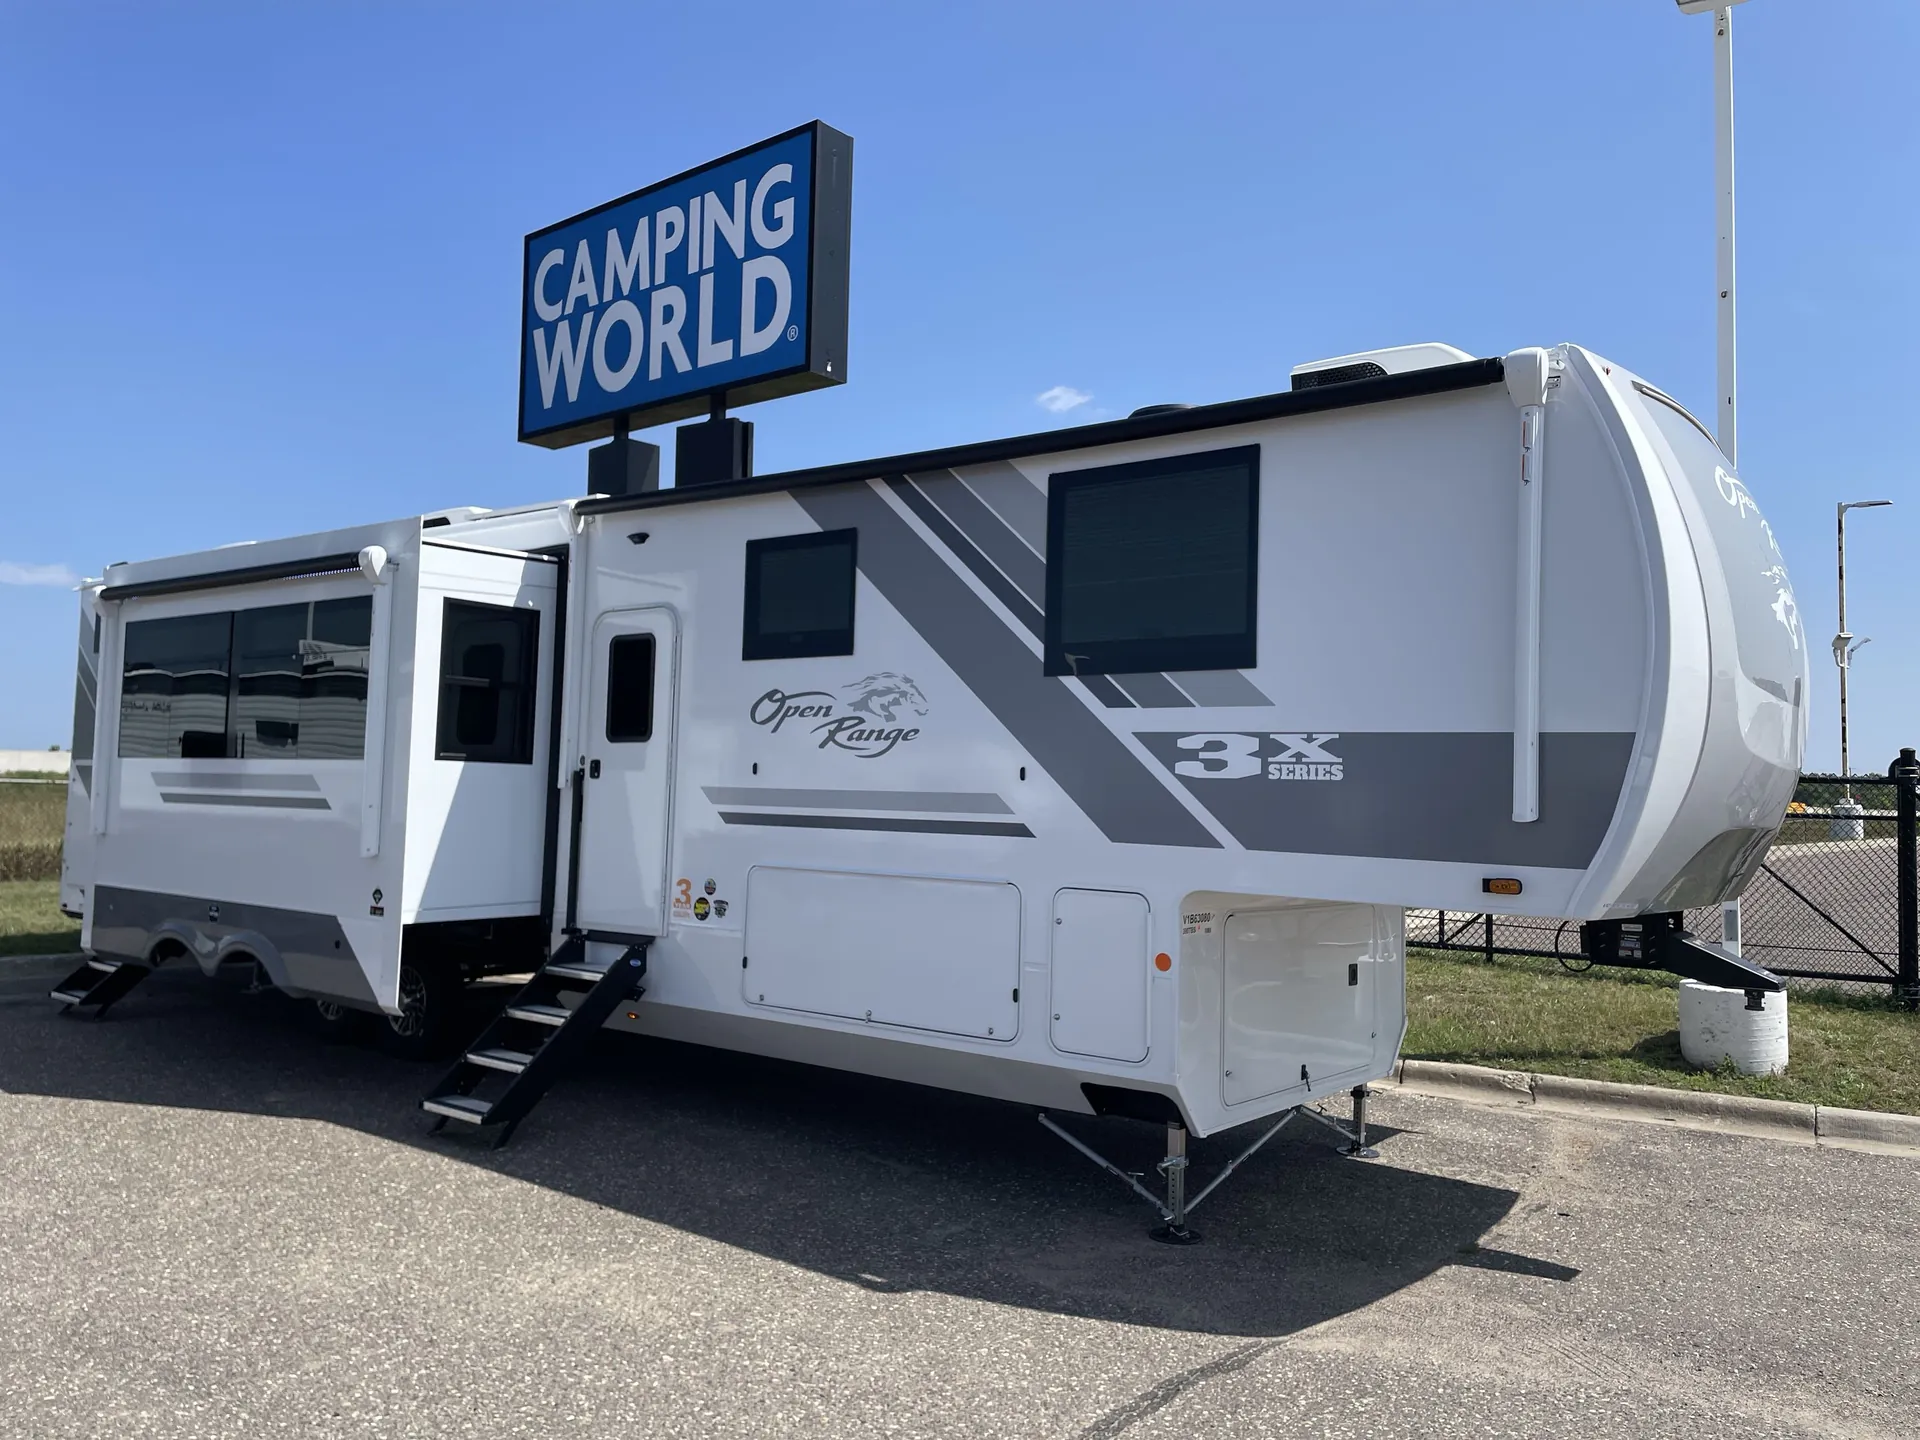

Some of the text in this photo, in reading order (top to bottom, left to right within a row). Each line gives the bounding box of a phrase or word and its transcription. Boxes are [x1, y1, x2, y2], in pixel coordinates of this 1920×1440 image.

[534, 163, 795, 322] CAMPING
[750, 688, 837, 733] Open
[810, 716, 920, 758] Range
[1268, 764, 1344, 781] SERIES
